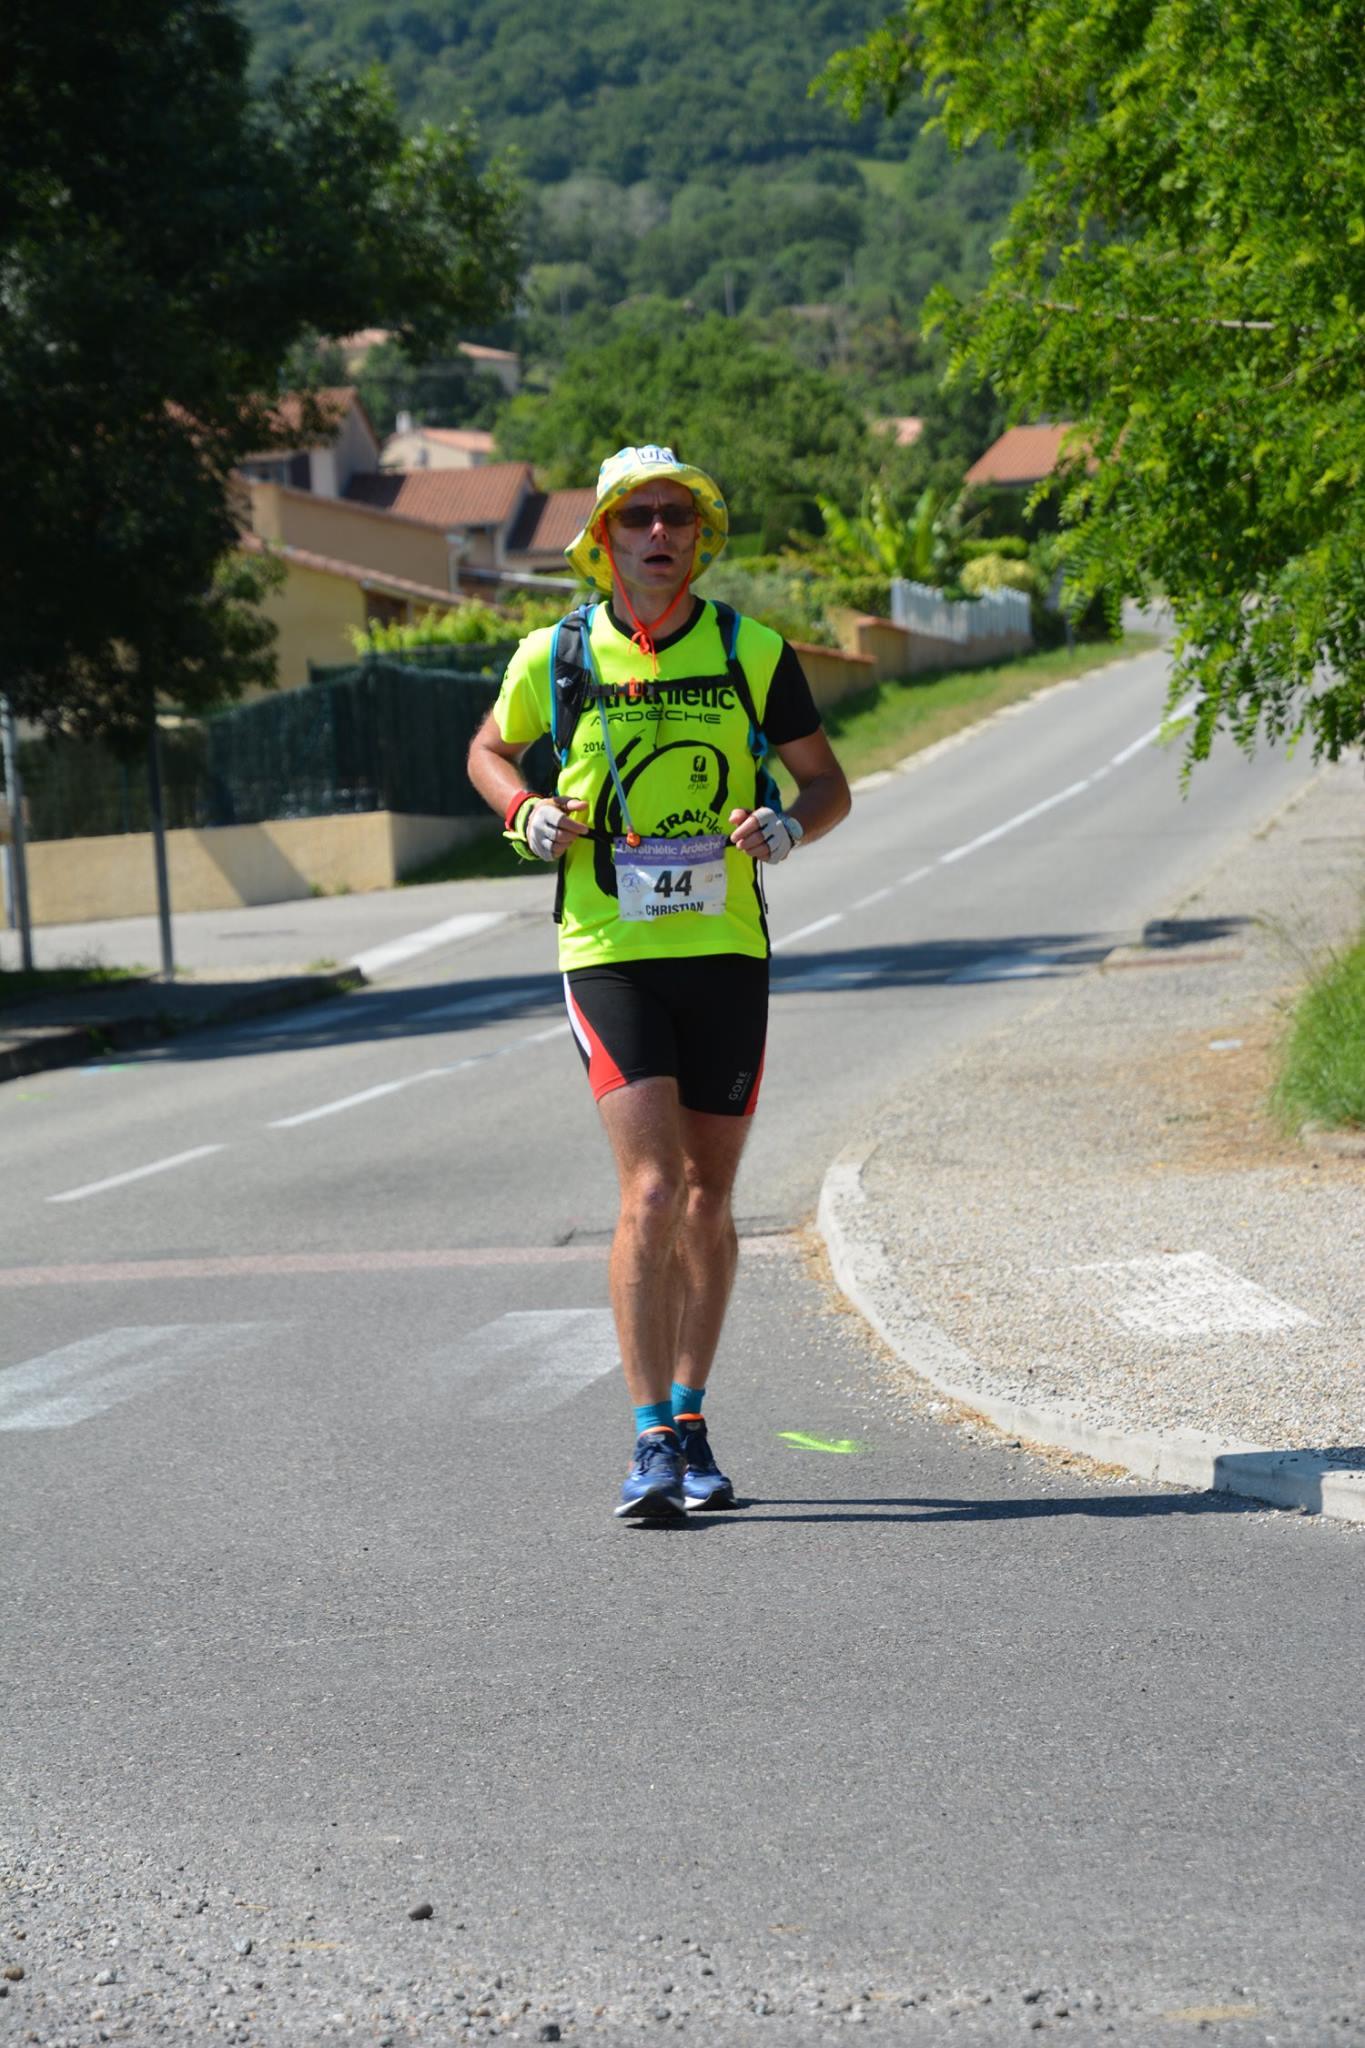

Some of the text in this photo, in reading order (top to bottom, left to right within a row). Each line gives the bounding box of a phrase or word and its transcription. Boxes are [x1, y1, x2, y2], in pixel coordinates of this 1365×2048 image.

[654, 870, 692, 898] 44
[645, 901, 704, 916] CHRISTIAN
[728, 1071, 748, 1101] GORE
